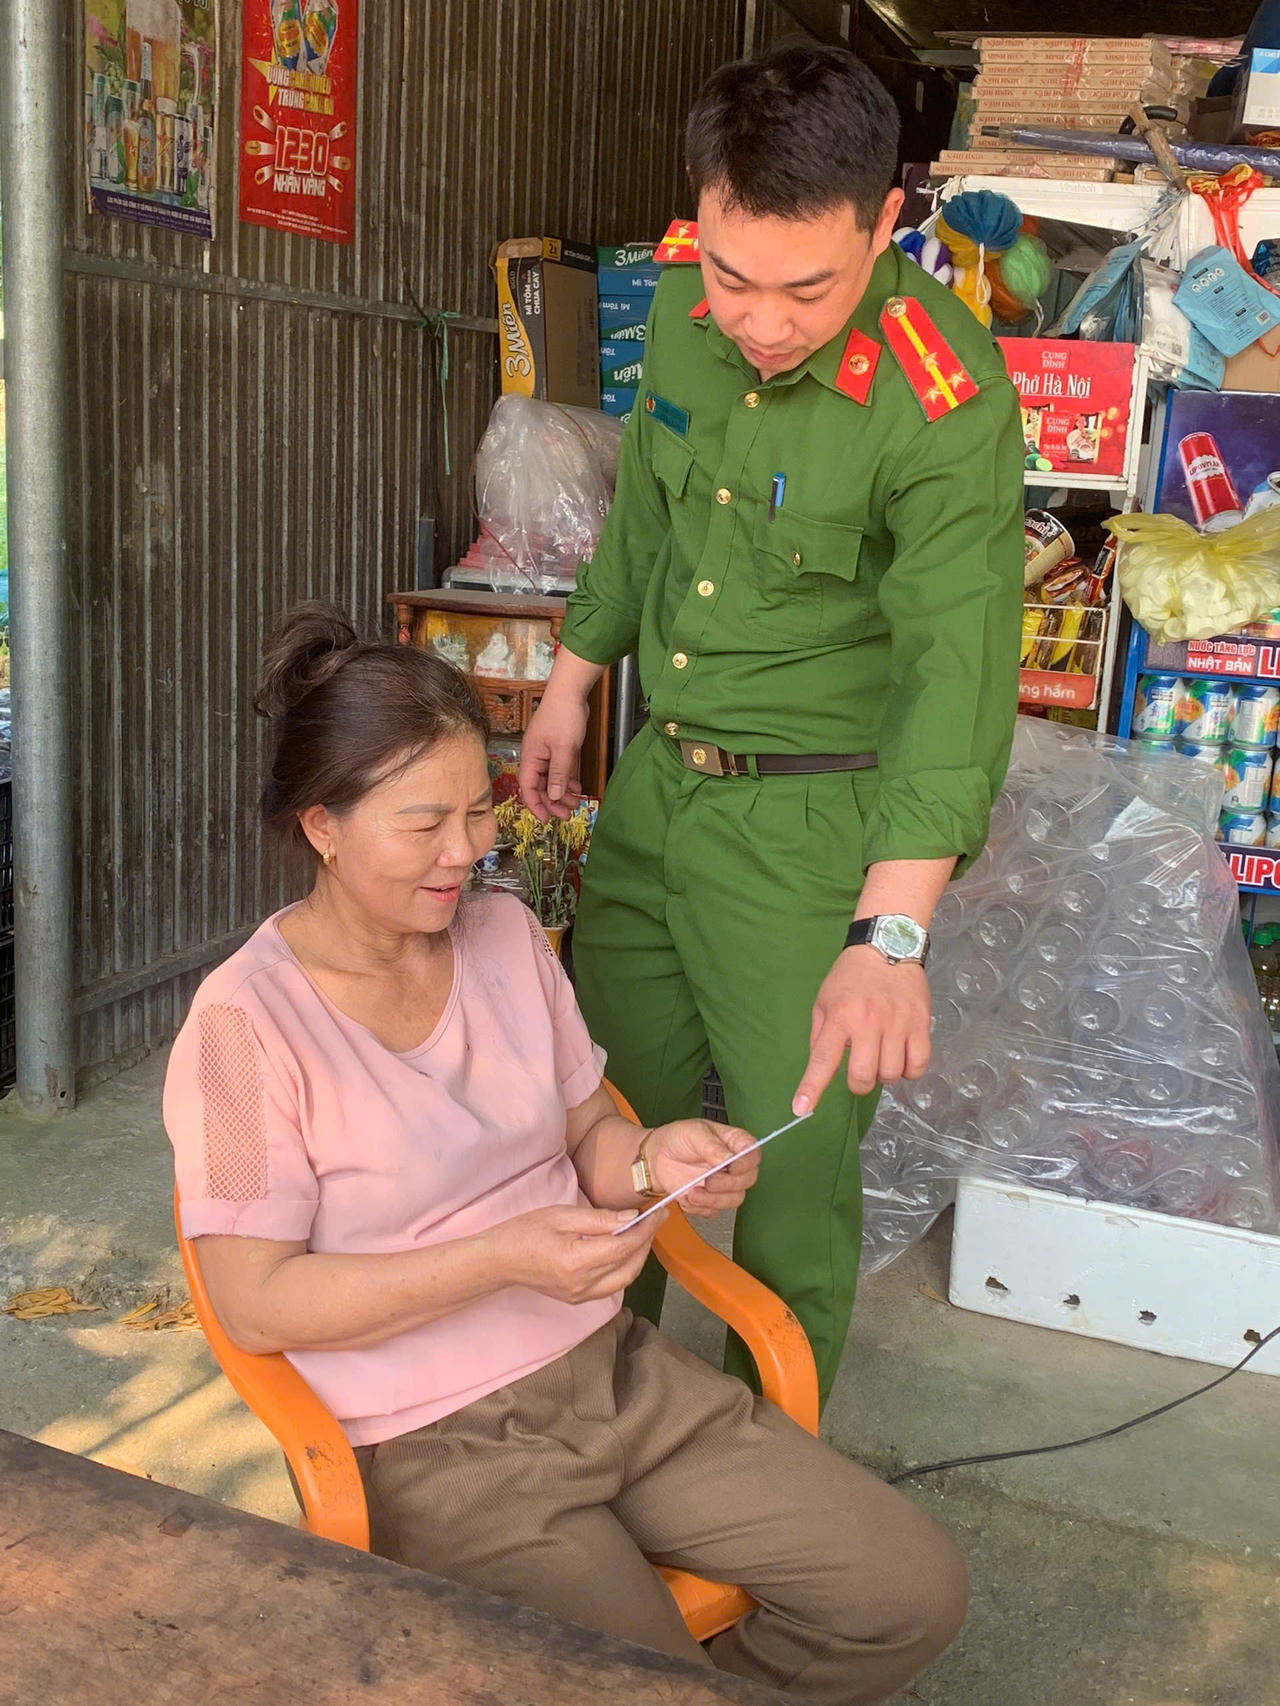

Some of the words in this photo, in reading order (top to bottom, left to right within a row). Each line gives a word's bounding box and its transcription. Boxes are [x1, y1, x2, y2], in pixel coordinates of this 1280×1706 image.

[532, 271, 540, 289] CAY
[523, 284, 532, 303] TÔM
[533, 291, 541, 315] CHUA
[1042, 351, 1067, 360] CUNG
[1012, 371, 1041, 394] Phở
[1043, 373, 1063, 395] Hà
[1067, 374, 1092, 399] Nội
[1188, 655, 1222, 672] NHẬT
[1225, 658, 1252, 673] BẢN
